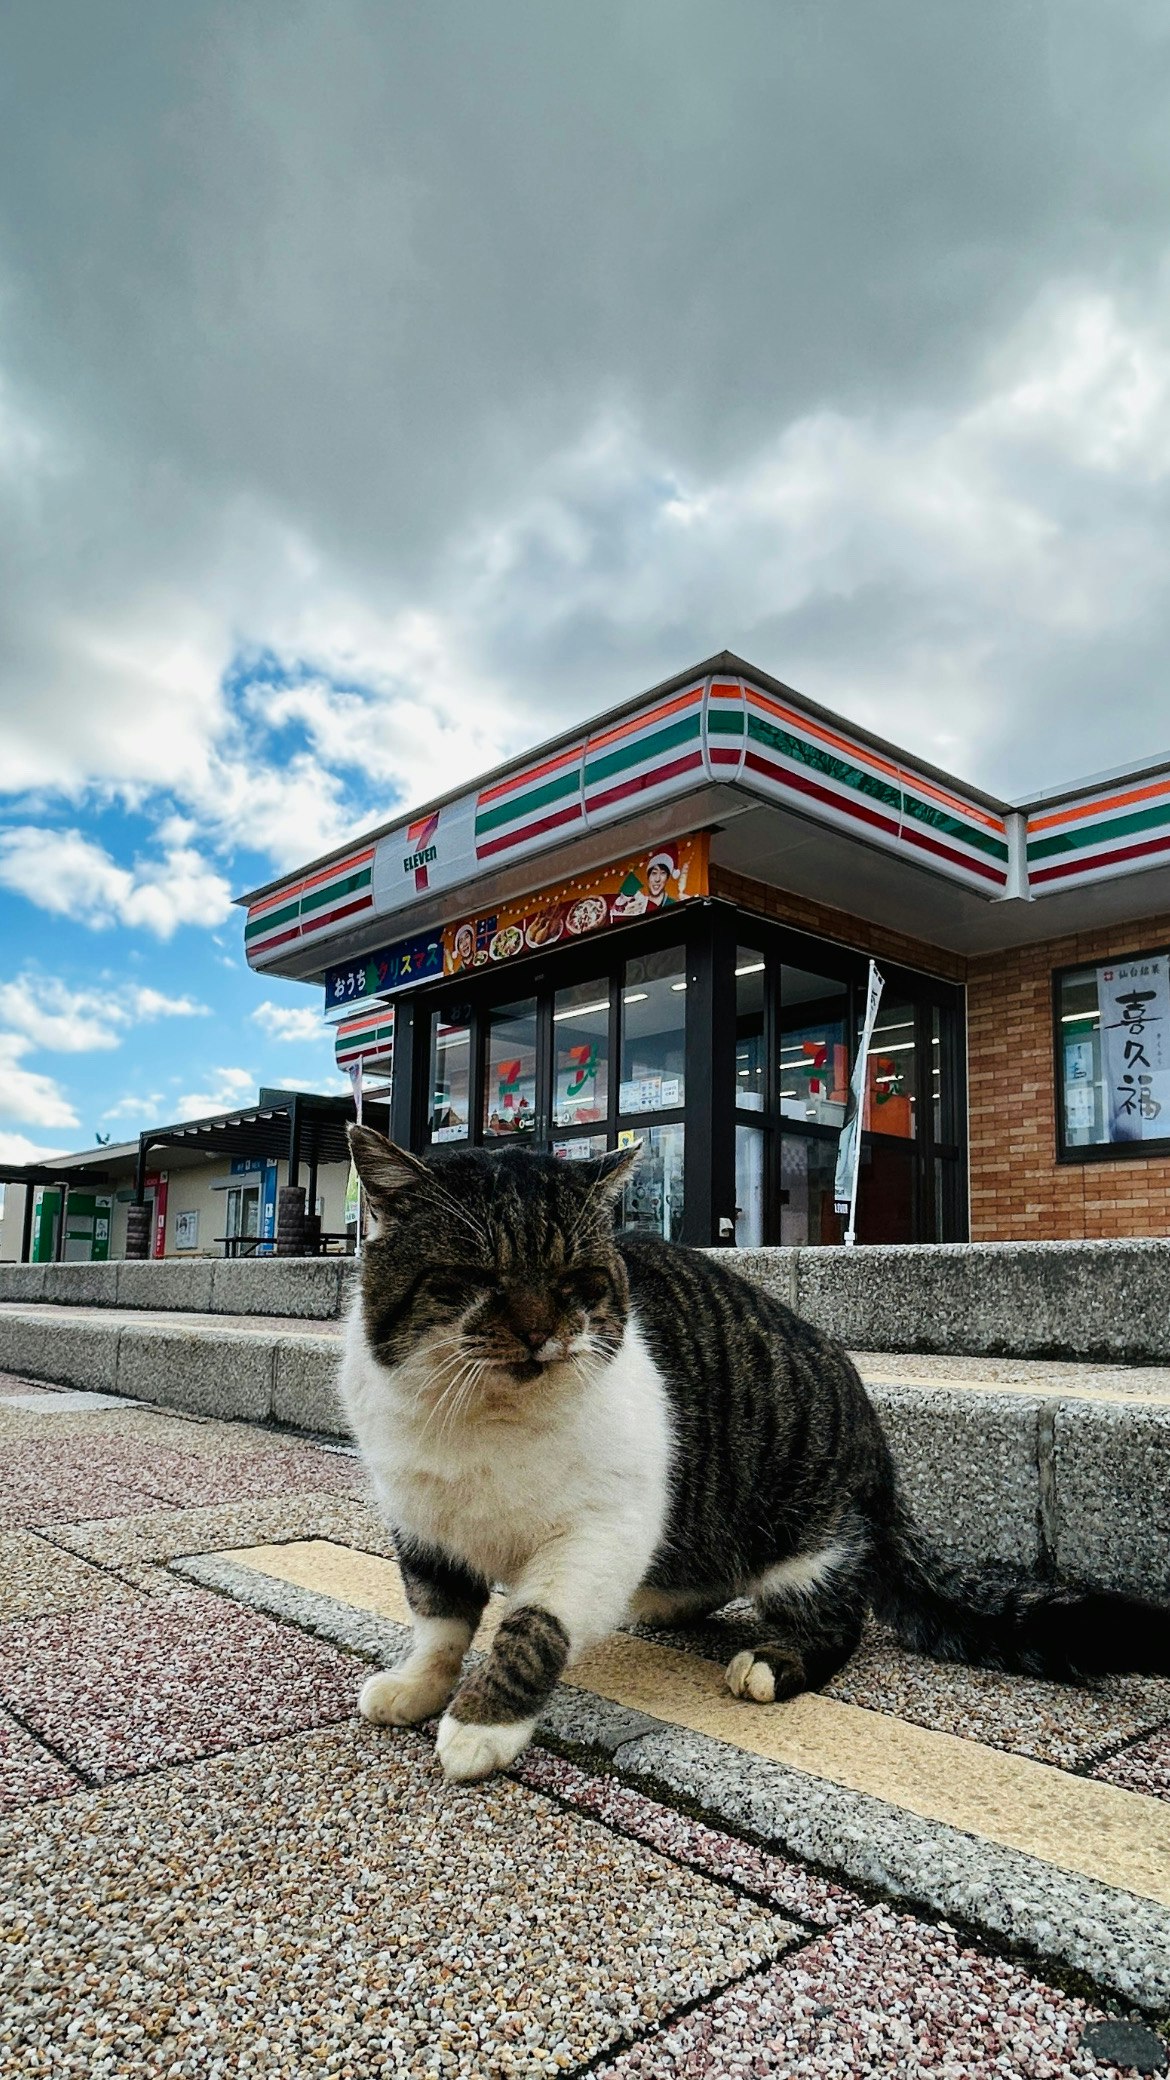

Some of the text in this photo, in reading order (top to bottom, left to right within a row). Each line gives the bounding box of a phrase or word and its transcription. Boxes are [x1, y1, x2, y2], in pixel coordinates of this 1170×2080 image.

[406, 811, 440, 892] 7
[334, 943, 438, 998] おうち クリスマス
[1105, 989, 1163, 1120] 喜久福
